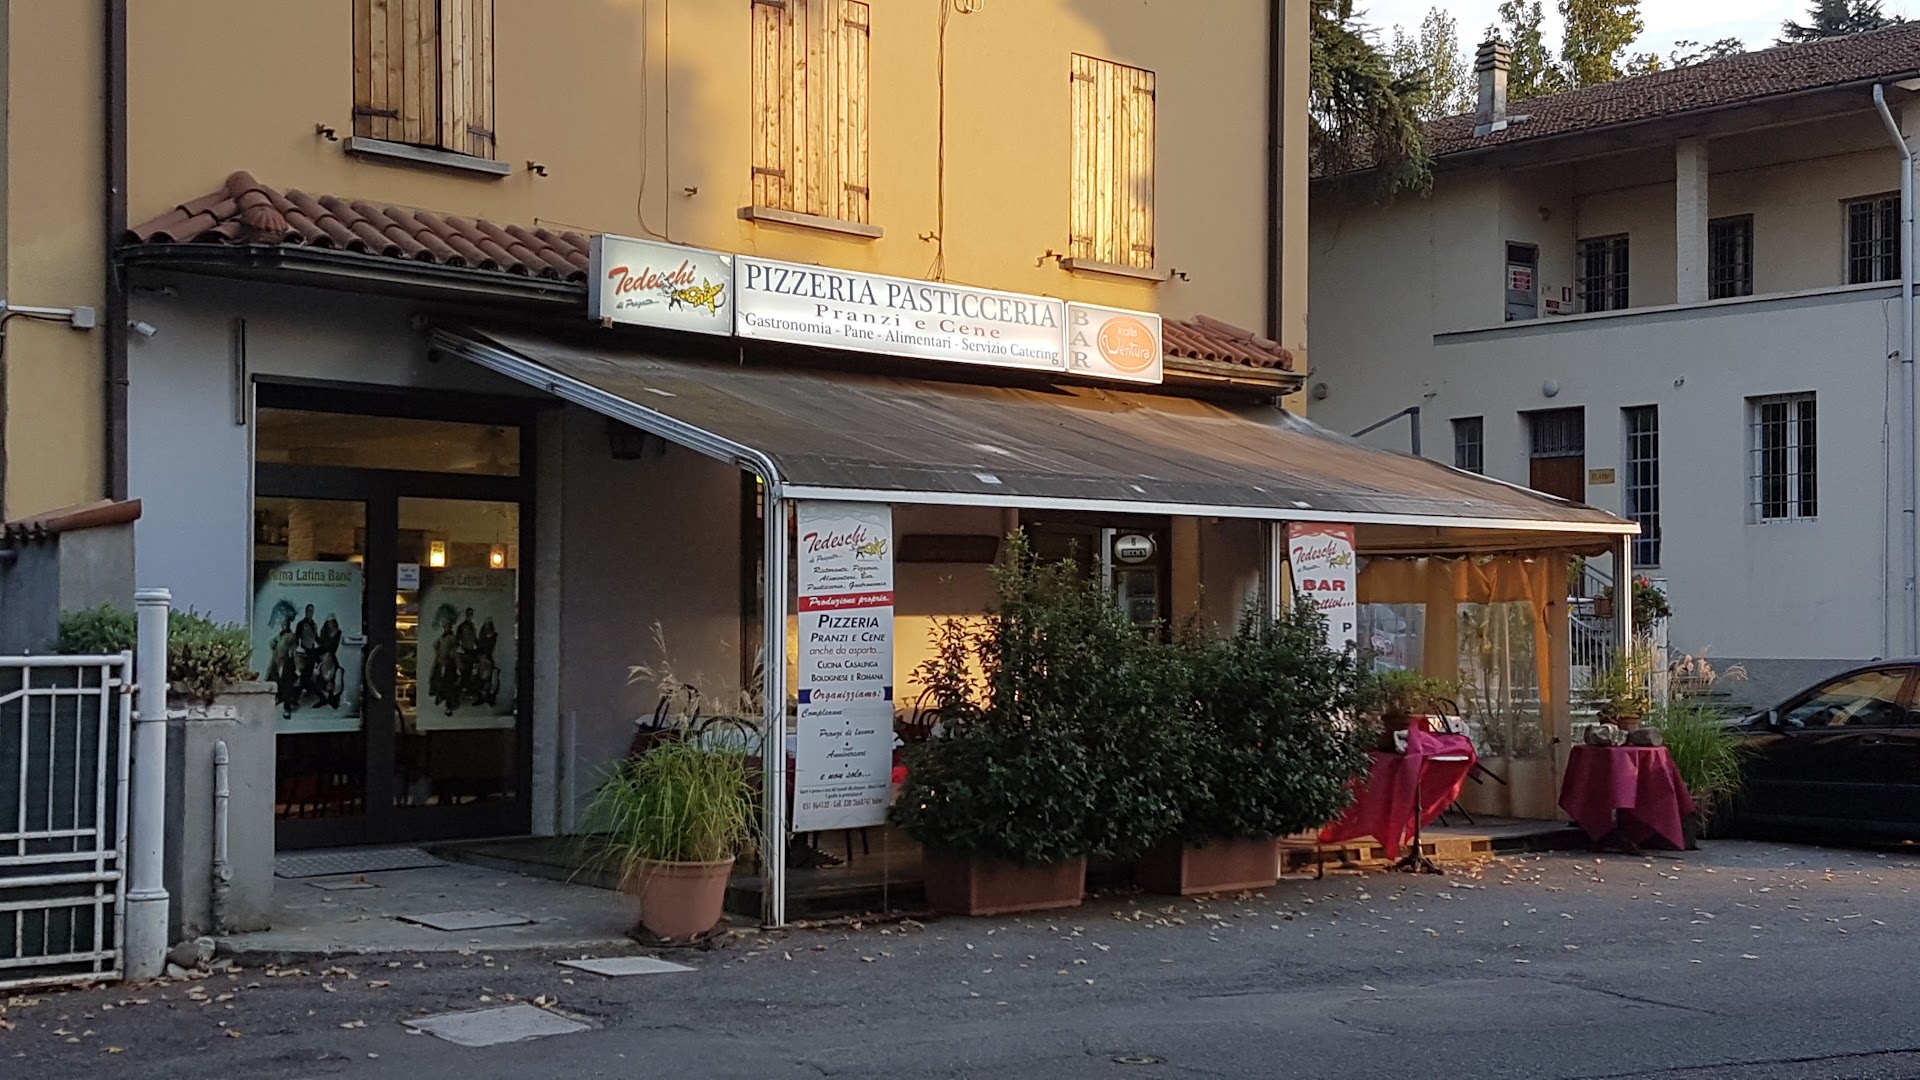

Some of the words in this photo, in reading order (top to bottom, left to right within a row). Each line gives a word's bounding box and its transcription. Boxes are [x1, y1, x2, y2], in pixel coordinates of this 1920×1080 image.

[608, 259, 697, 295] Tedeschi
[745, 263, 878, 307] PIZZERIA
[886, 282, 1058, 329] PASTICCERIA
[815, 303, 900, 327] Pranzi
[915, 319, 926, 330] e
[939, 319, 1000, 339] Cene
[745, 312, 832, 335] Gastronomia
[844, 324, 874, 340] Pane
[885, 330, 951, 349] Alimentari
[962, 338, 1007, 355] Servizio
[1010, 344, 1059, 365] Catering
[1101, 334, 1150, 359] Ventura
[803, 524, 867, 554] Tedeschi
[1292, 540, 1337, 564] Tedeschi
[296, 569, 325, 581] Latina
[1303, 579, 1346, 591] BAR
[809, 596, 856, 608] Produzione
[818, 614, 879, 628] PIZZERIA
[810, 632, 848, 642] PRANZI
[861, 631, 886, 642] CENE
[809, 645, 834, 655] anche
[836, 645, 846, 654] da
[817, 660, 842, 669] CUCINA
